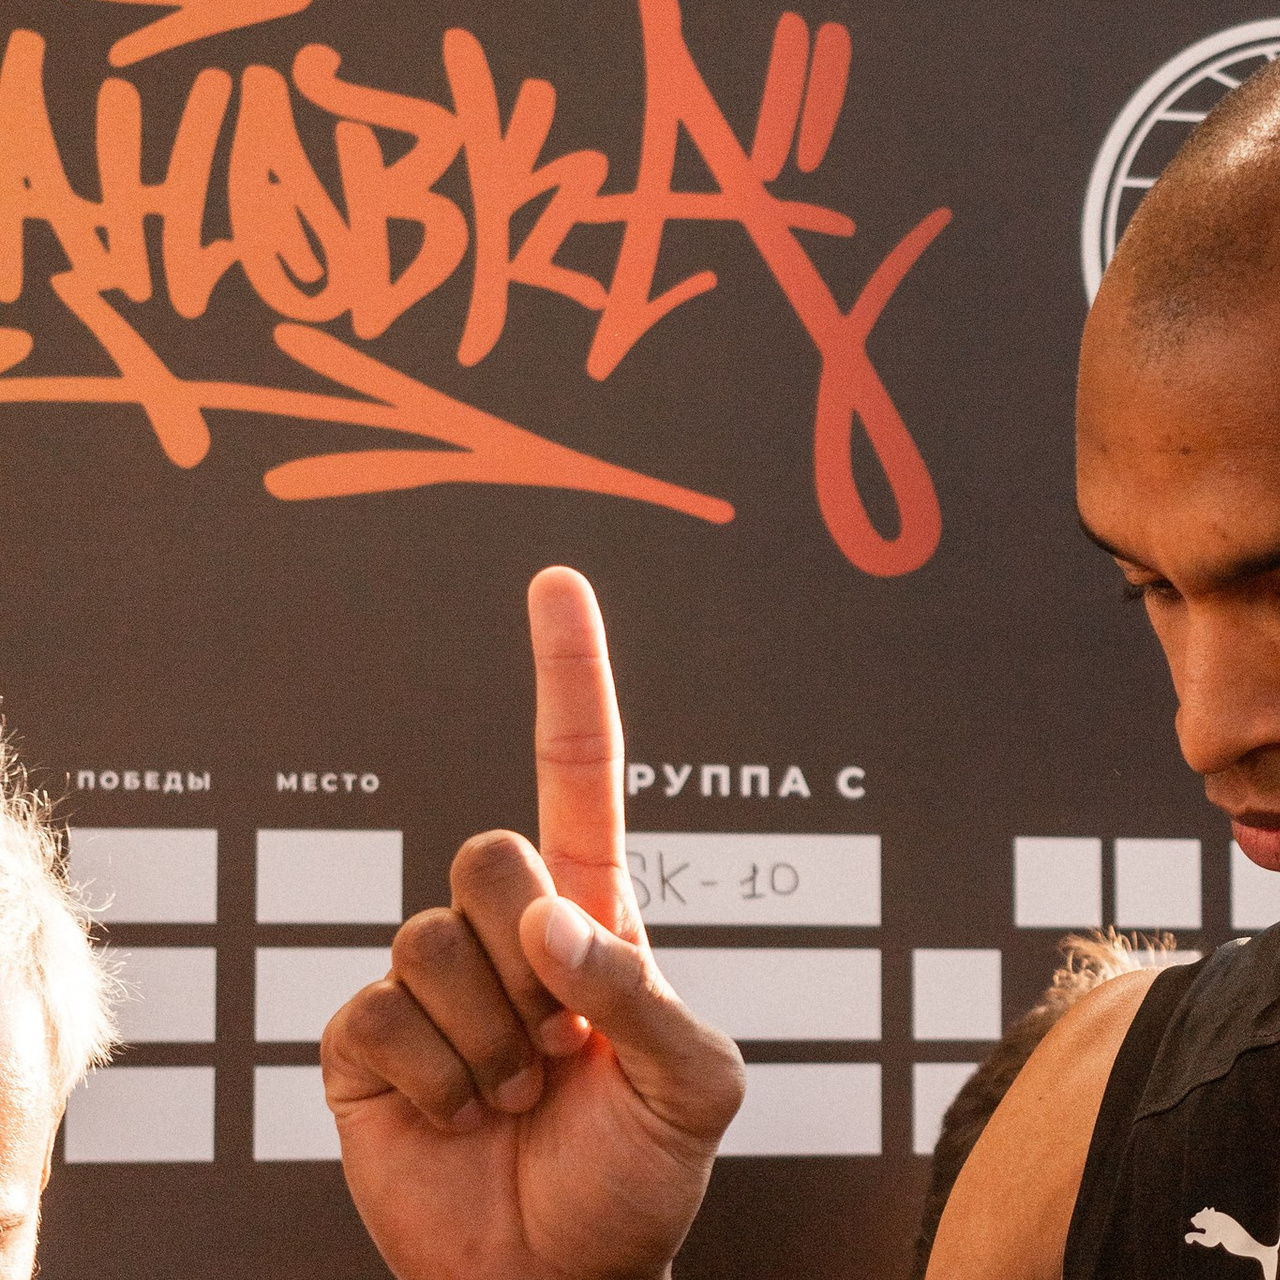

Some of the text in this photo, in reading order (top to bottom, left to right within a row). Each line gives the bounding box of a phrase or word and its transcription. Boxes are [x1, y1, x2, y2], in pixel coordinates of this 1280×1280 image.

[77, 770, 211, 794] ПОБЕДЫ
[276, 772, 380, 793] МЕСТО
[627, 763, 812, 798] РУППА
